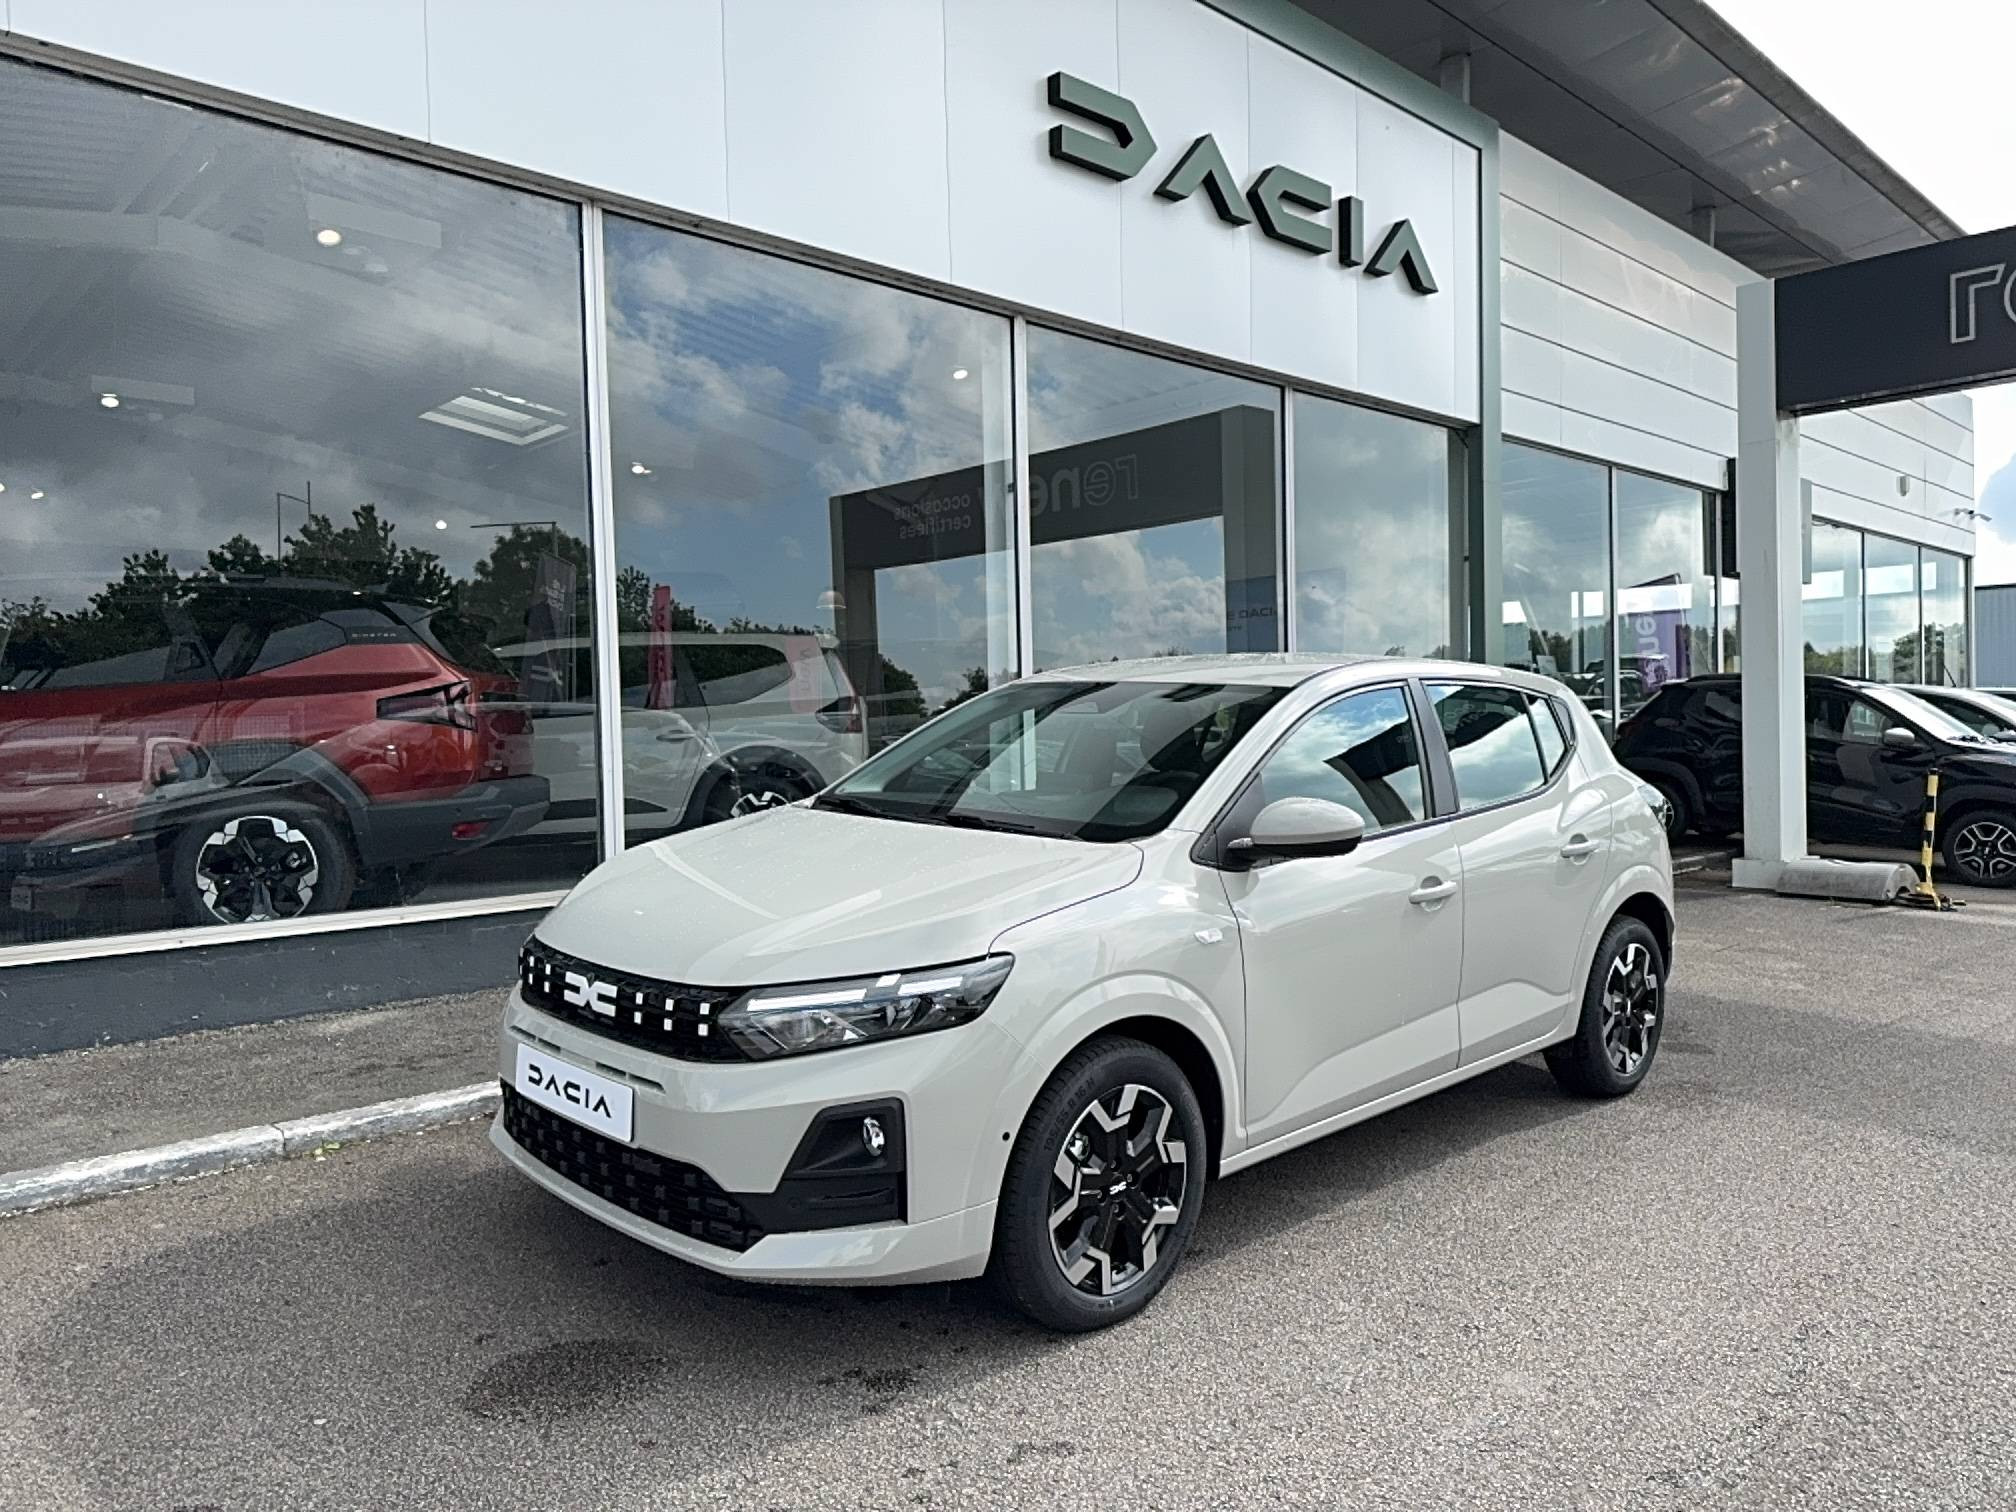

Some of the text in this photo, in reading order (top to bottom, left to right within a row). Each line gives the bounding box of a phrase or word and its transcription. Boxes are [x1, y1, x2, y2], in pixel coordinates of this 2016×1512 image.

[1047, 71, 1438, 295] DACIA
[1950, 262, 2016, 343] r
[528, 1063, 611, 1118] DACIA
